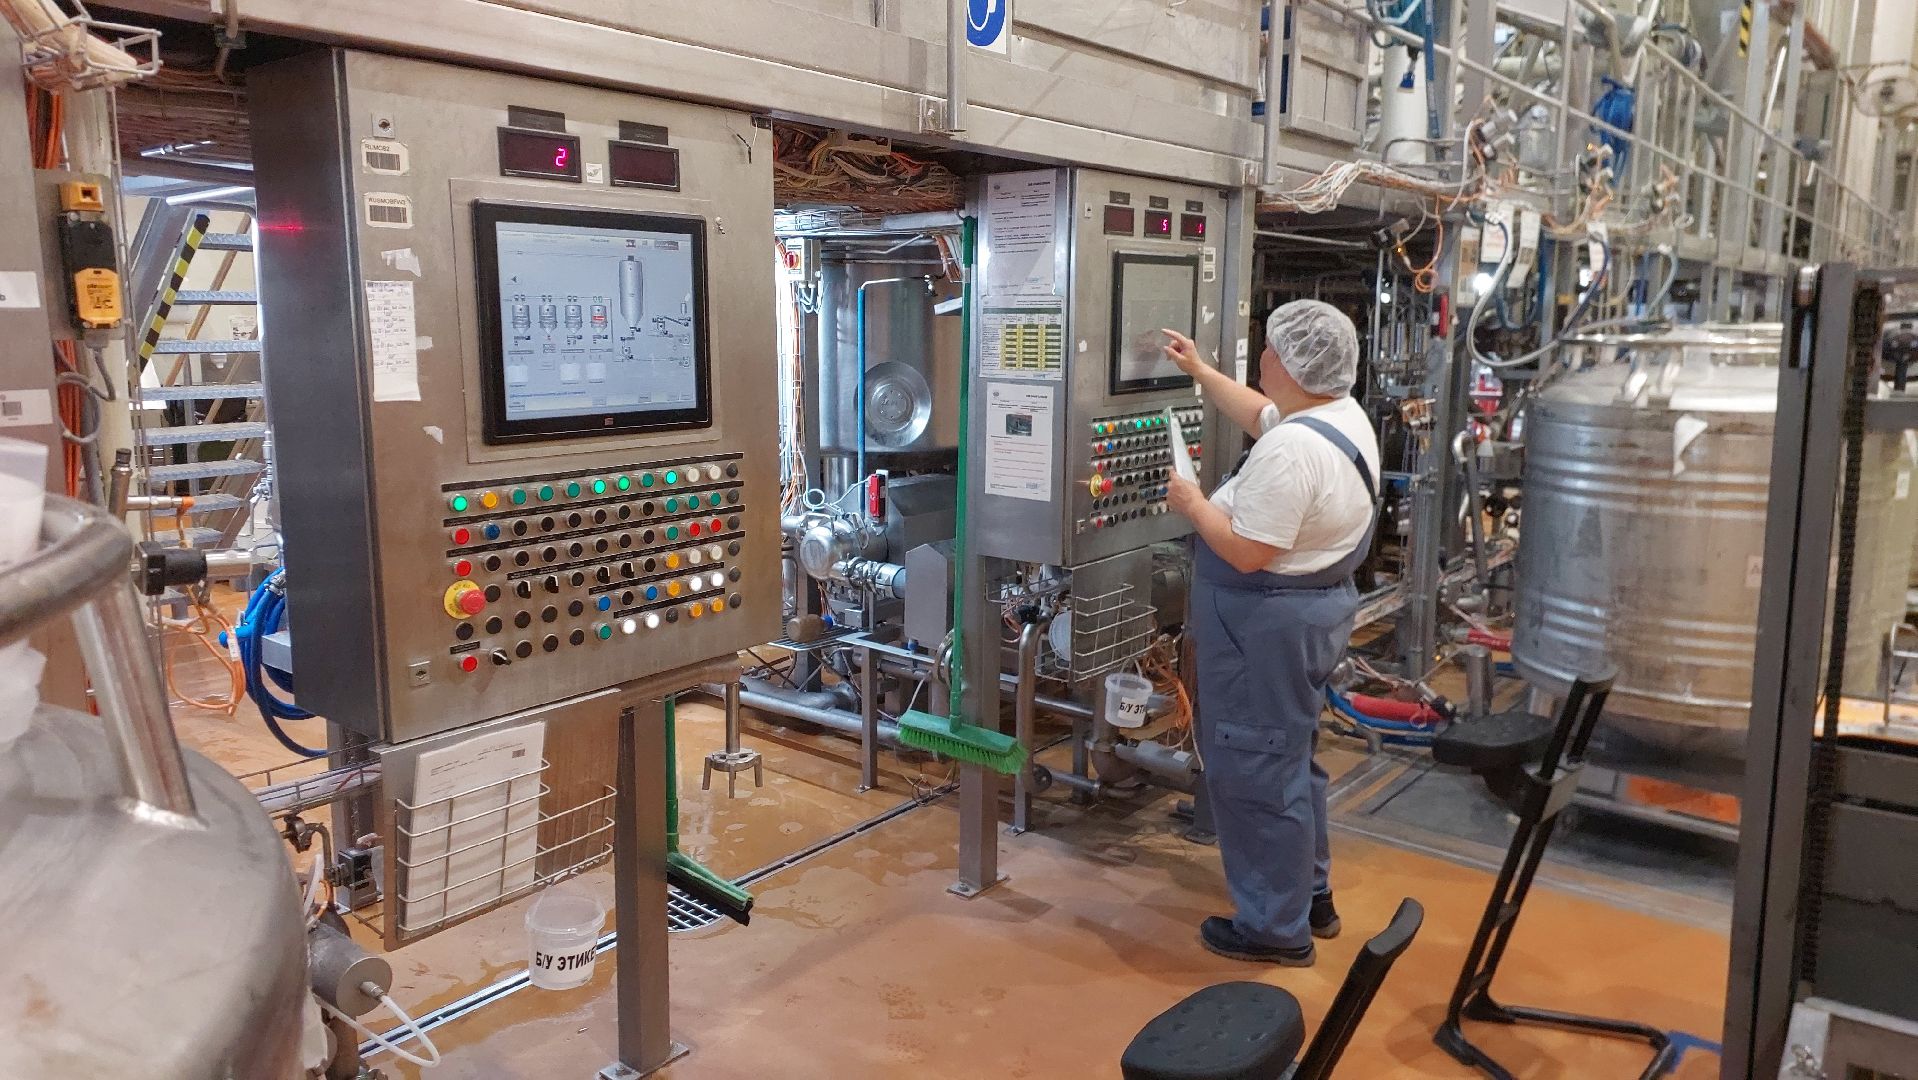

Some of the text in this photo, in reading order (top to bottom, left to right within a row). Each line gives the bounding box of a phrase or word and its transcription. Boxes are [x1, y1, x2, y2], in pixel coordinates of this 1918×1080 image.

[555, 147, 568, 168] 2
[1162, 219, 1168, 231] 5
[1120, 702, 1132, 712] Б/У
[536, 951, 553, 969] Б/У
